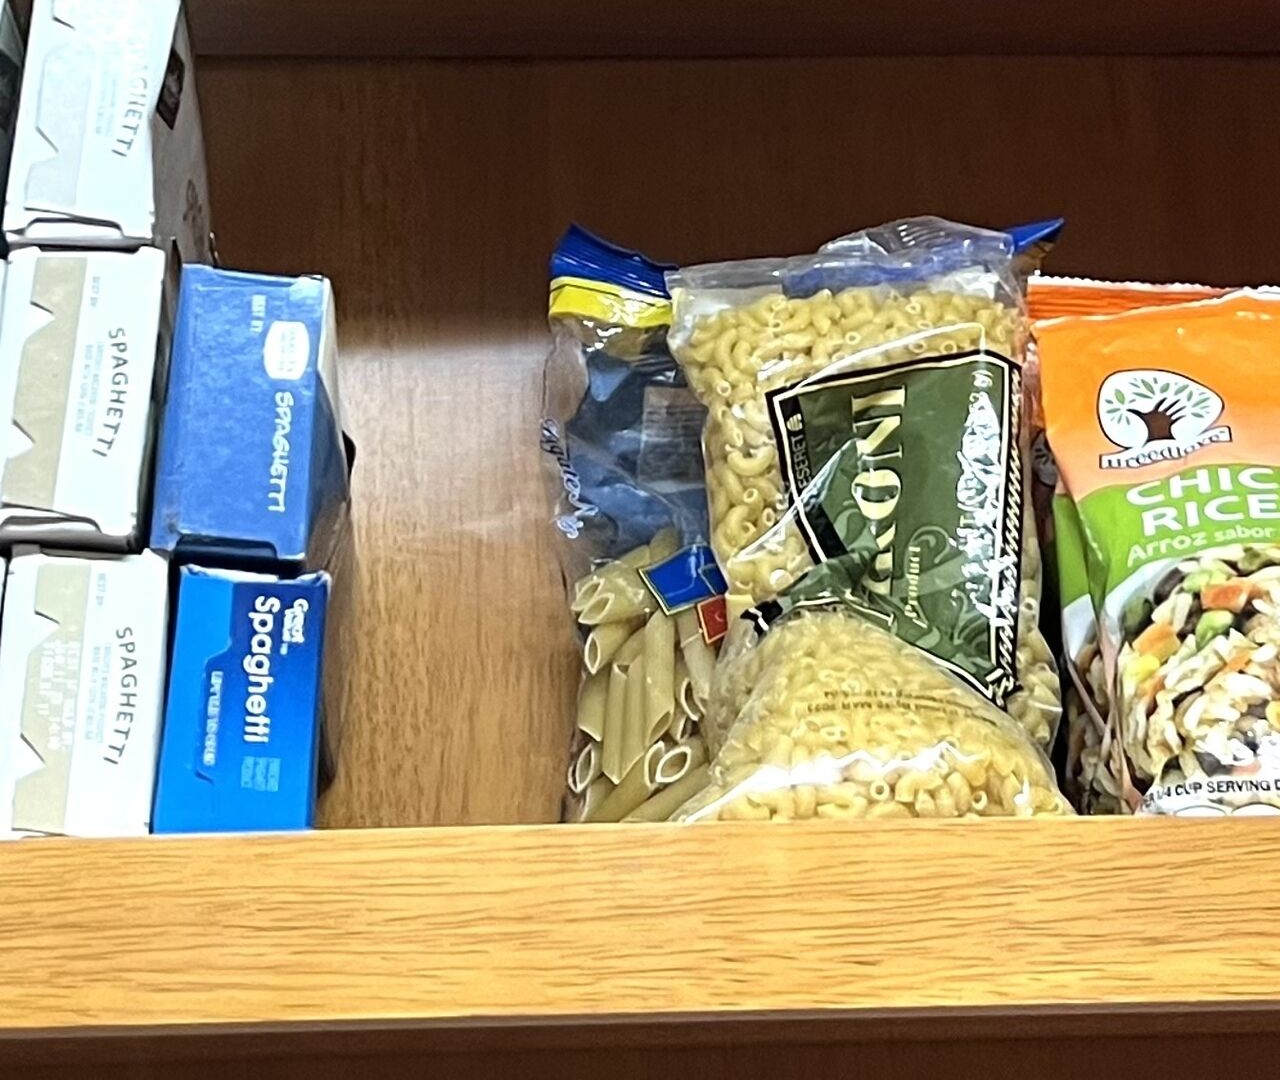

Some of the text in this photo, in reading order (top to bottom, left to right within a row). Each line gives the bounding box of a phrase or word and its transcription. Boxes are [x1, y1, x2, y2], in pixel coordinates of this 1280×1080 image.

[112, 40, 149, 157] GHETTI
[92, 328, 129, 457] SPAGHETTI
[267, 391, 294, 513] SPAGHETTI
[791, 434, 813, 490] ESERET
[1127, 534, 1207, 567] Arroz
[1214, 524, 1276, 544] sabor
[103, 627, 138, 765] SPAGHETTI
[242, 595, 282, 744] Spaghetti
[1207, 779, 1271, 794] SERVING
